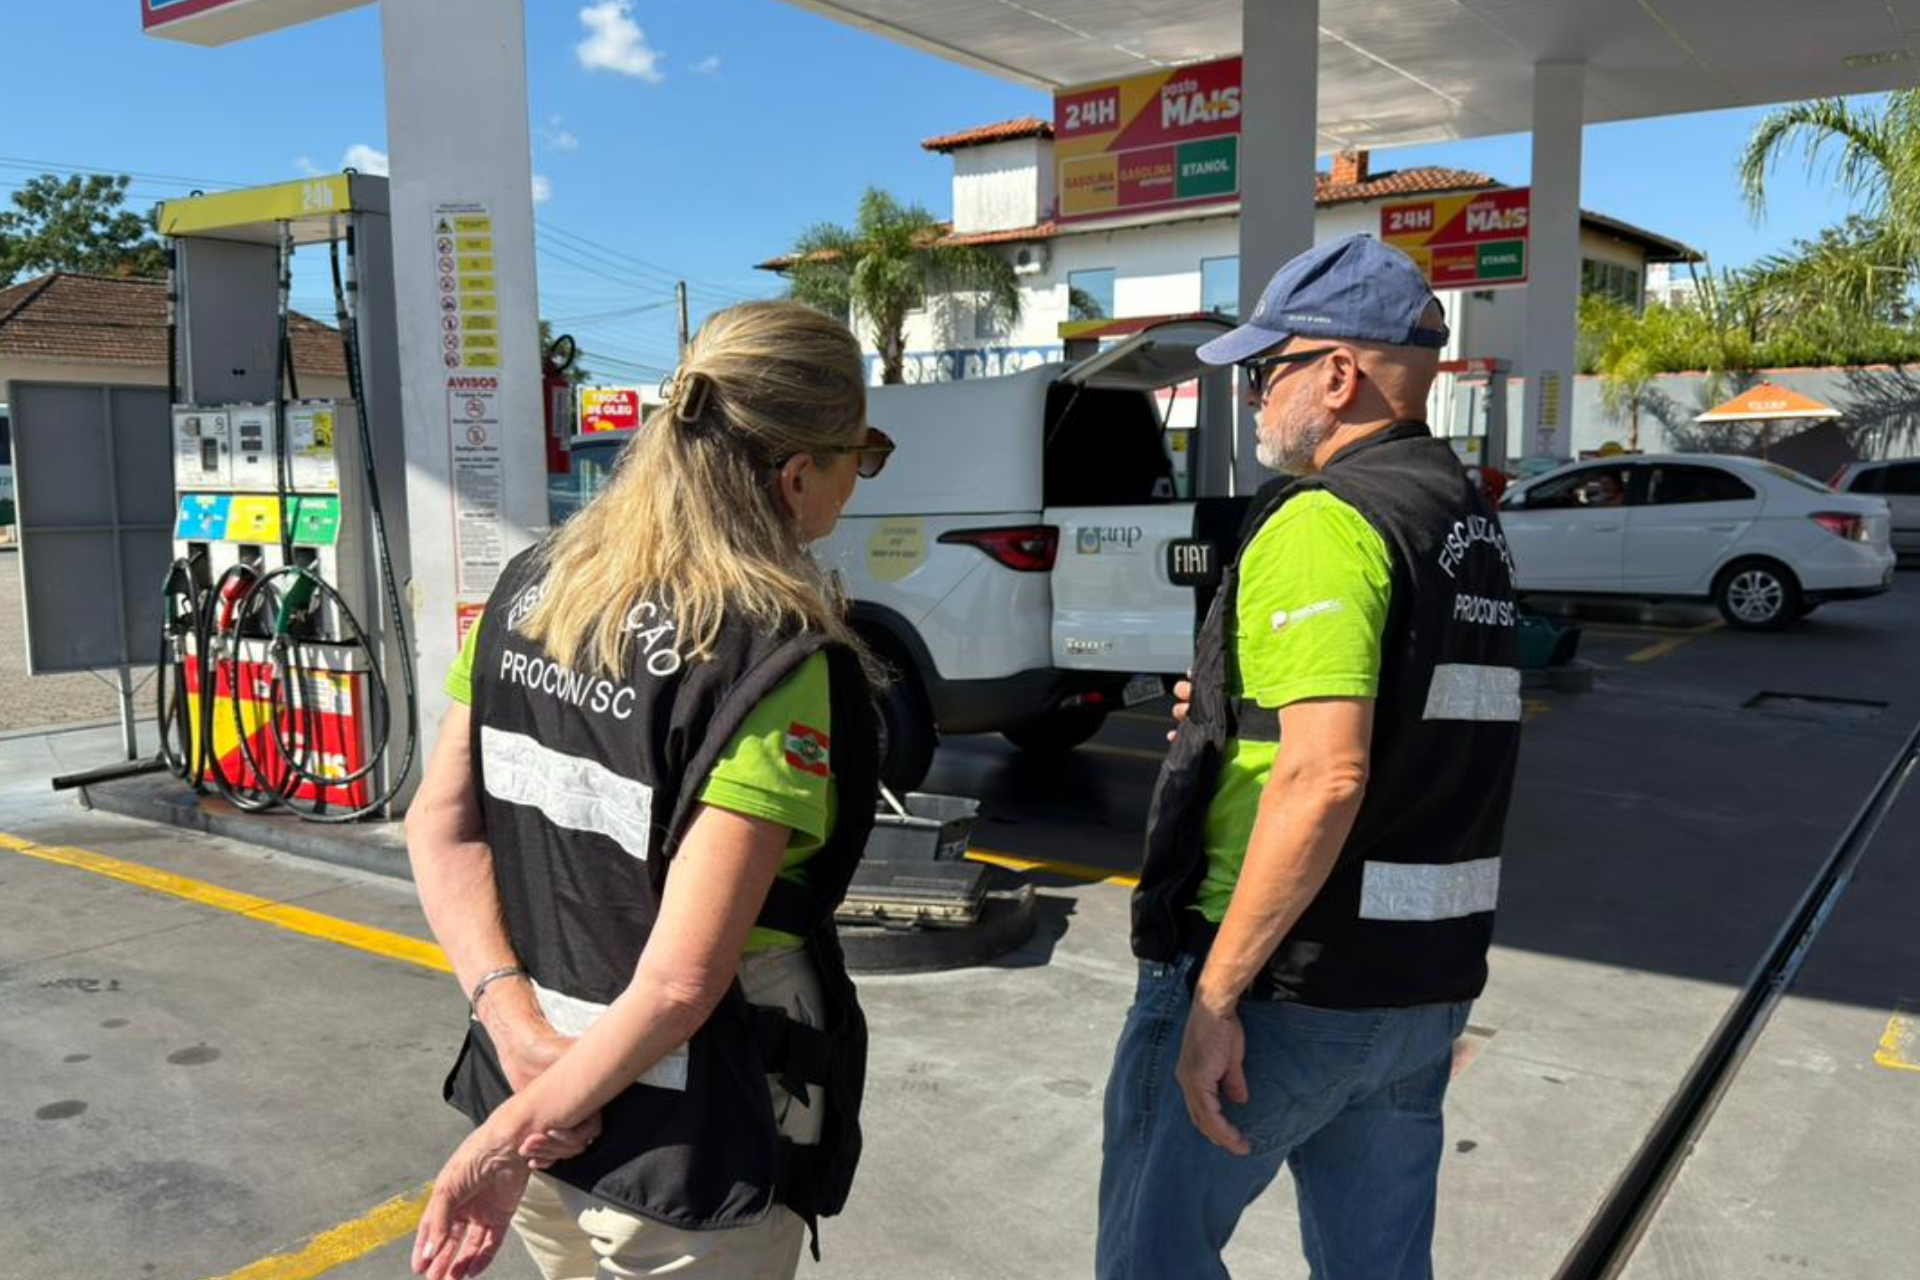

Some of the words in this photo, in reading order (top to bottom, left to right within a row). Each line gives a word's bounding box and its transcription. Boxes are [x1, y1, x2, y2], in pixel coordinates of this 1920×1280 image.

[1065, 97, 1116, 130] 24H
[1161, 87, 1241, 129] MAIS
[1182, 159, 1230, 178] ETANOL
[1390, 209, 1431, 230] 24H
[1466, 207, 1528, 234] MAIS
[447, 376, 498, 389] AVISOS
[1173, 544, 1211, 574] FIAT
[499, 649, 637, 720] PROCON/SC
